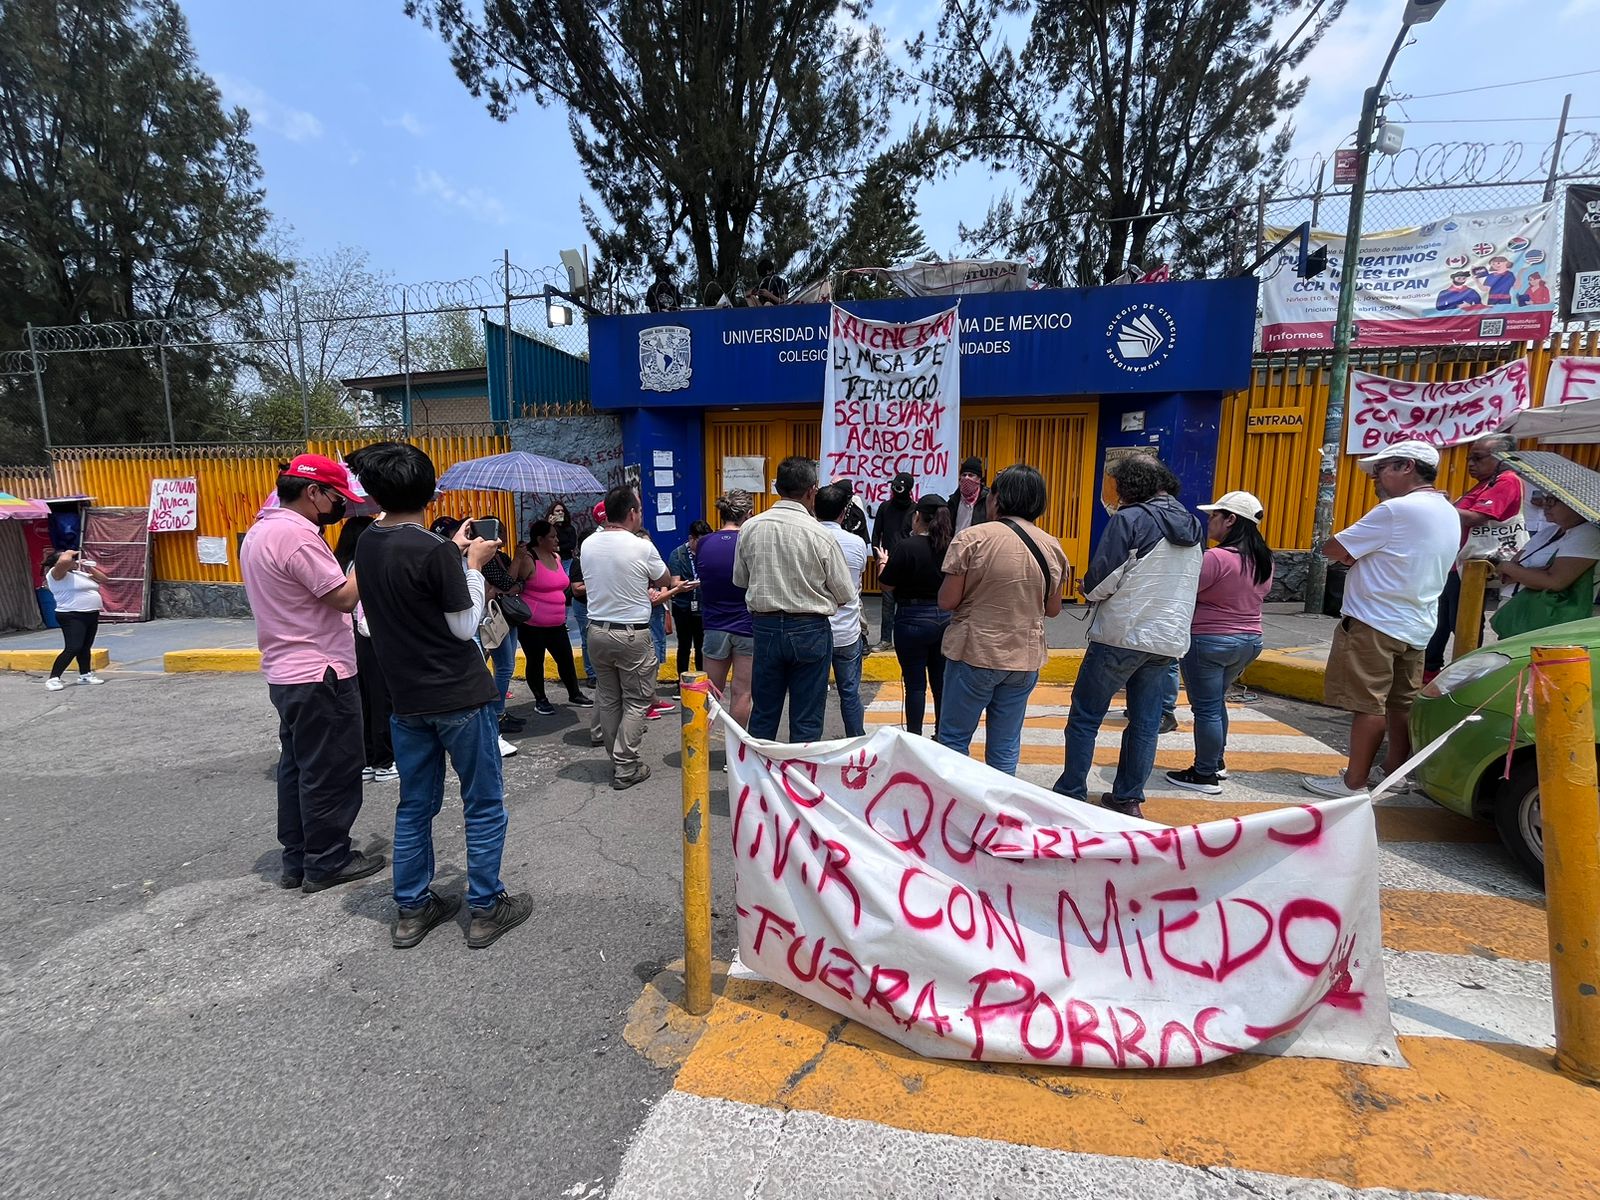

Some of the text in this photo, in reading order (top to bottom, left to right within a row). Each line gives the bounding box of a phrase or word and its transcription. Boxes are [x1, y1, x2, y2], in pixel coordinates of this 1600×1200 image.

[1387, 268, 1410, 278] EN
[1293, 279, 1430, 293] CCH NUCALPAN
[723, 326, 814, 345] UNIVERSIDAD
[983, 316, 1005, 332] DE
[1009, 312, 1072, 331] MEXICO
[1105, 304, 1138, 336] COLEGIO
[1158, 307, 1176, 349] CIENCIAS
[1268, 331, 1324, 342] Informes
[778, 348, 829, 362] COLEGIO
[834, 344, 945, 373] LA MESA DE
[1249, 415, 1303, 426] ENTRADA
[899, 867, 1026, 963] CON
